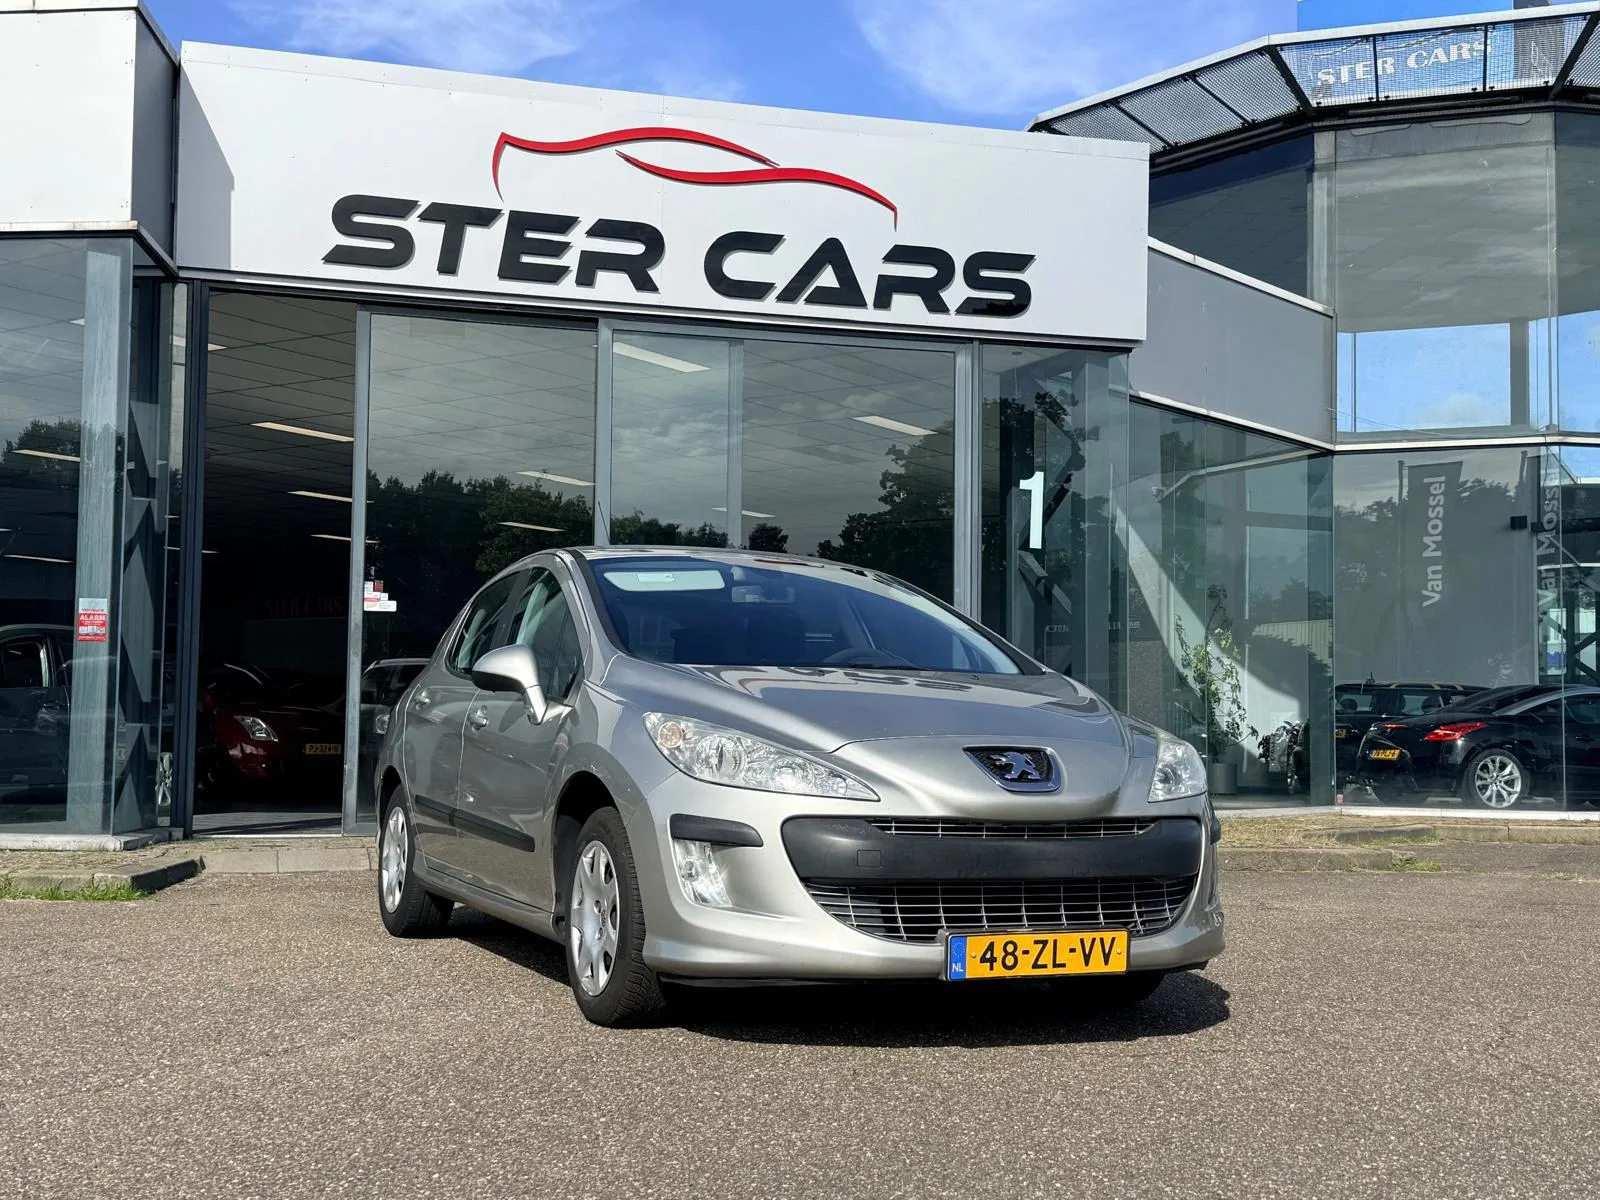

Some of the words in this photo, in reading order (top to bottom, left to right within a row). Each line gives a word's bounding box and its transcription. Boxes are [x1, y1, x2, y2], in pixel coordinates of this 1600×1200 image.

[1316, 56, 1395, 86] STER
[1407, 40, 1492, 68] CARS
[321, 193, 665, 293] STER
[704, 230, 1037, 317] CARS
[1019, 471, 1045, 550] 1
[1422, 475, 1446, 558] Mossel
[1422, 565, 1443, 607] Van
[952, 963, 964, 973] NL
[979, 936, 1117, 971] 48-ZL-VV
